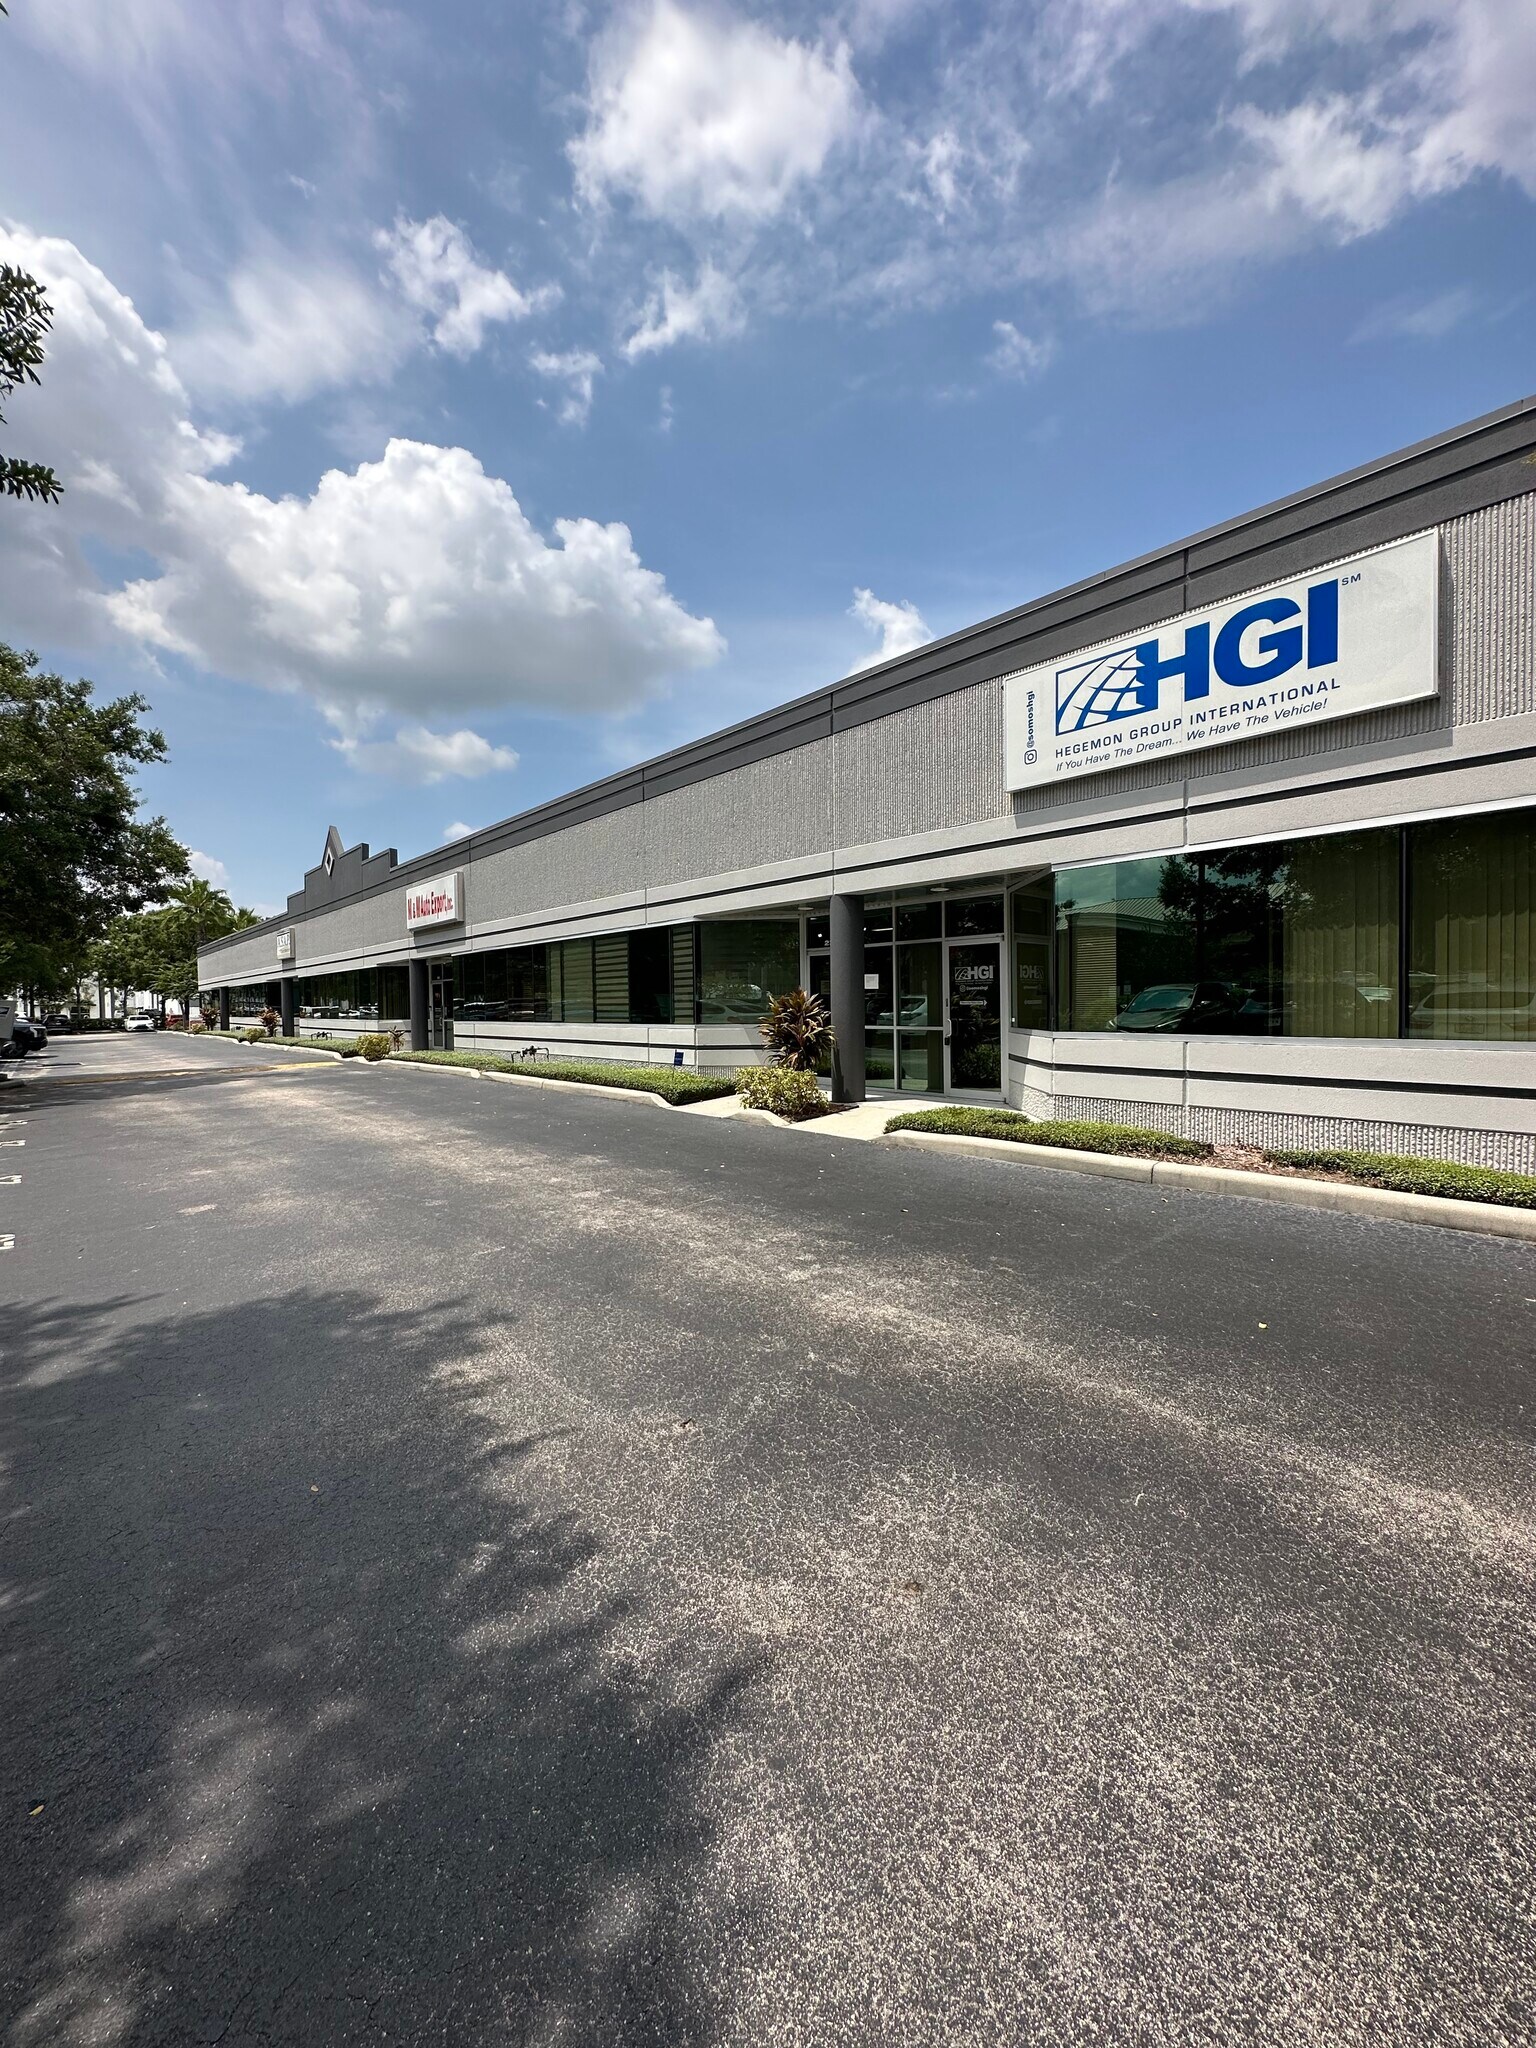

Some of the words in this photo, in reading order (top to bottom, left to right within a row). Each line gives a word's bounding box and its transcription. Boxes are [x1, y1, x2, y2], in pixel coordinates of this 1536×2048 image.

[1341, 573, 1361, 586] SM
[1136, 578, 1338, 710] HGI
[1026, 690, 1036, 748] @somoshgi
[1055, 732, 1123, 759] HEGEMON
[1129, 717, 1182, 740] GROUP
[1190, 678, 1341, 725] INTERNATIONAL
[1056, 762, 1063, 772] If
[1065, 759, 1083, 771] You
[1085, 752, 1110, 766] Have
[1114, 747, 1133, 759] The
[1136, 737, 1182, 753] Dream...
[1186, 729, 1205, 741] We
[1208, 721, 1240, 736] Have
[1245, 714, 1269, 727] The
[1274, 698, 1328, 720] Vehicle!
[968, 965, 994, 979] HGI
